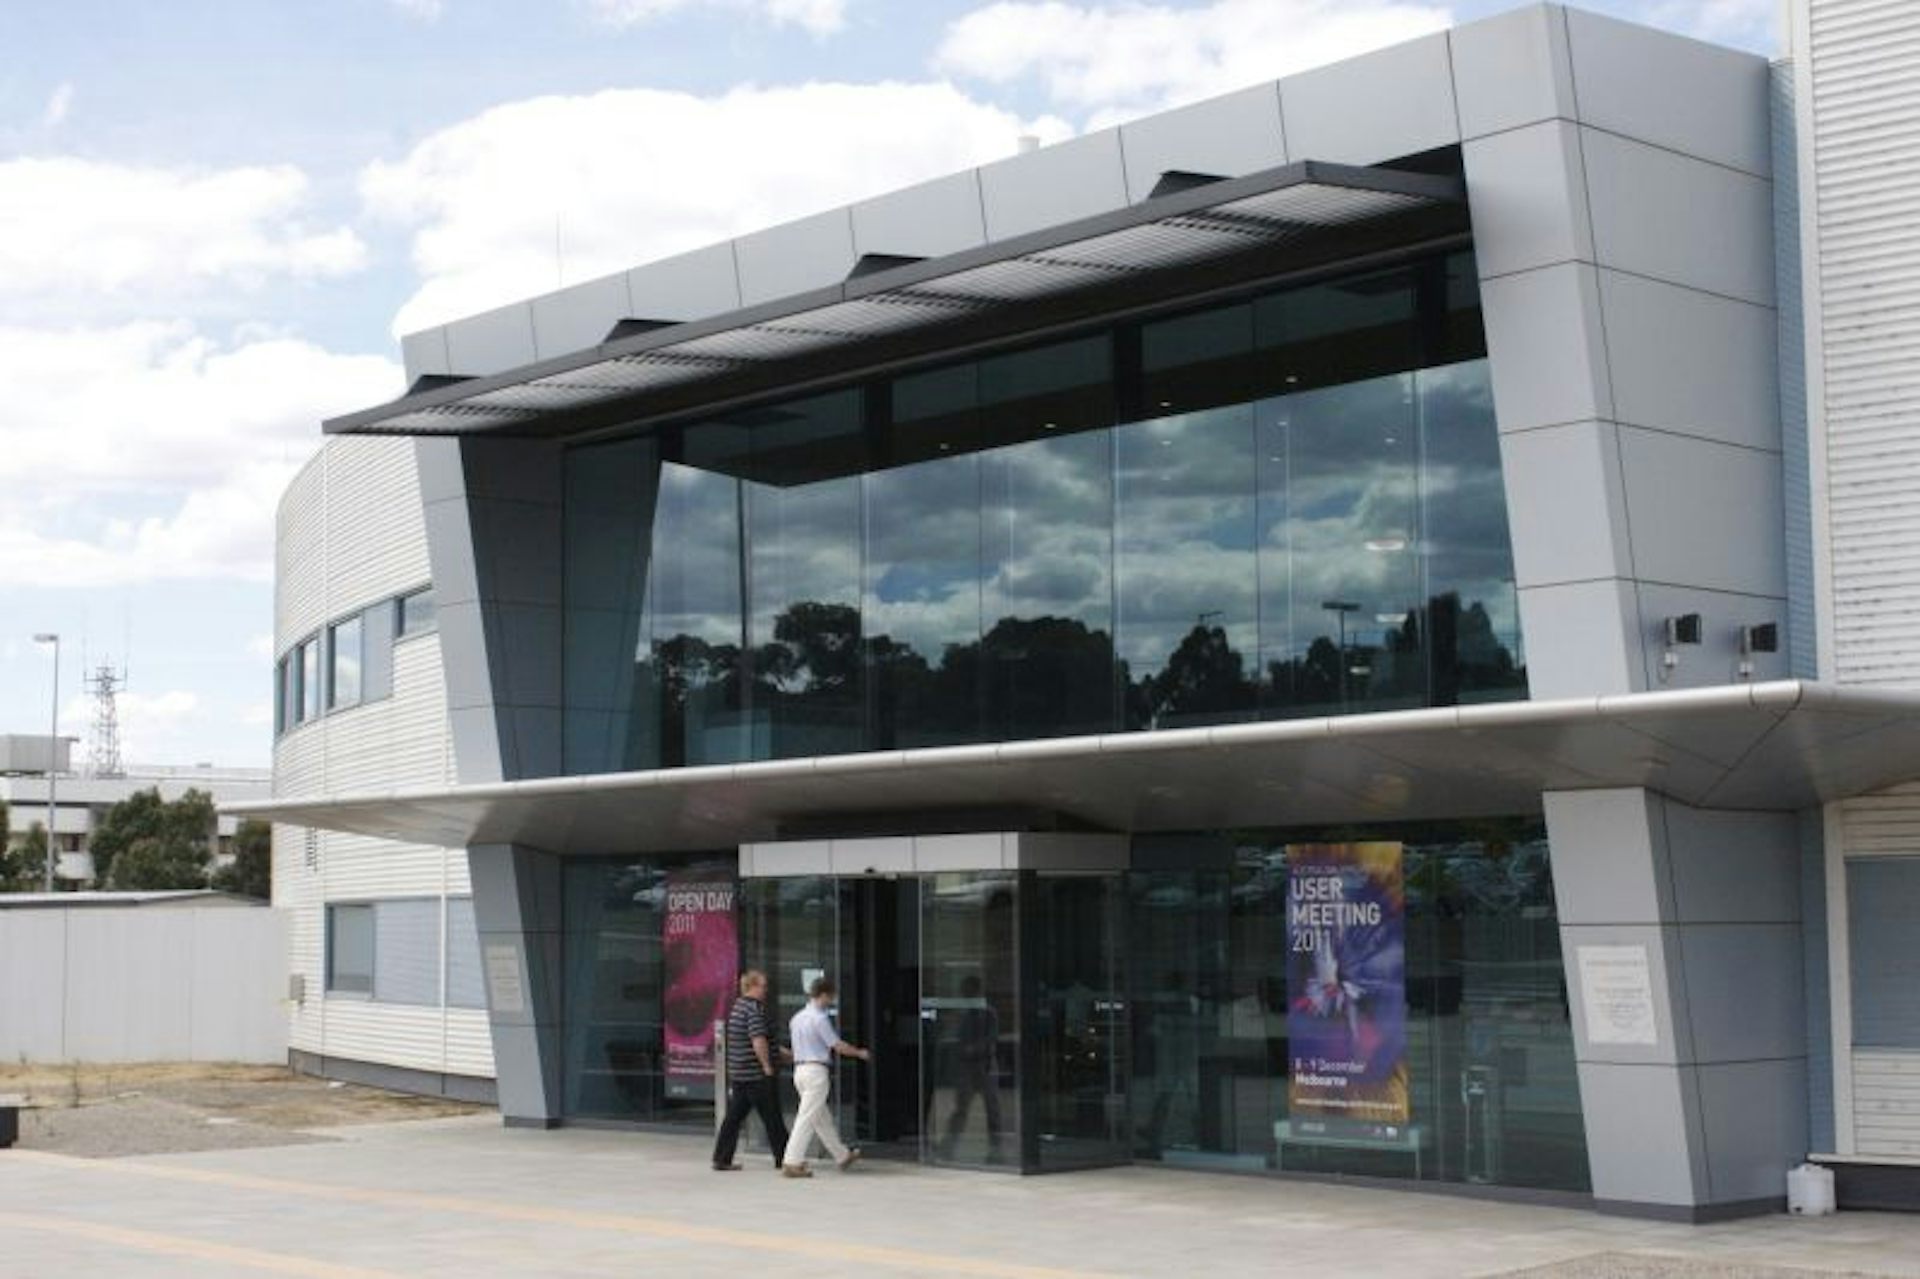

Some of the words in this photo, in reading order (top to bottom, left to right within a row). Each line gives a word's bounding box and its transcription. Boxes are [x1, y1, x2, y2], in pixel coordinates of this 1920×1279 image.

[1290, 877, 1343, 901] USER
[668, 892, 704, 912] OPEN
[707, 892, 733, 911] DAY
[668, 914, 695, 934] 2011
[1291, 902, 1381, 926] MEETING
[1292, 928, 1332, 951] 2011
